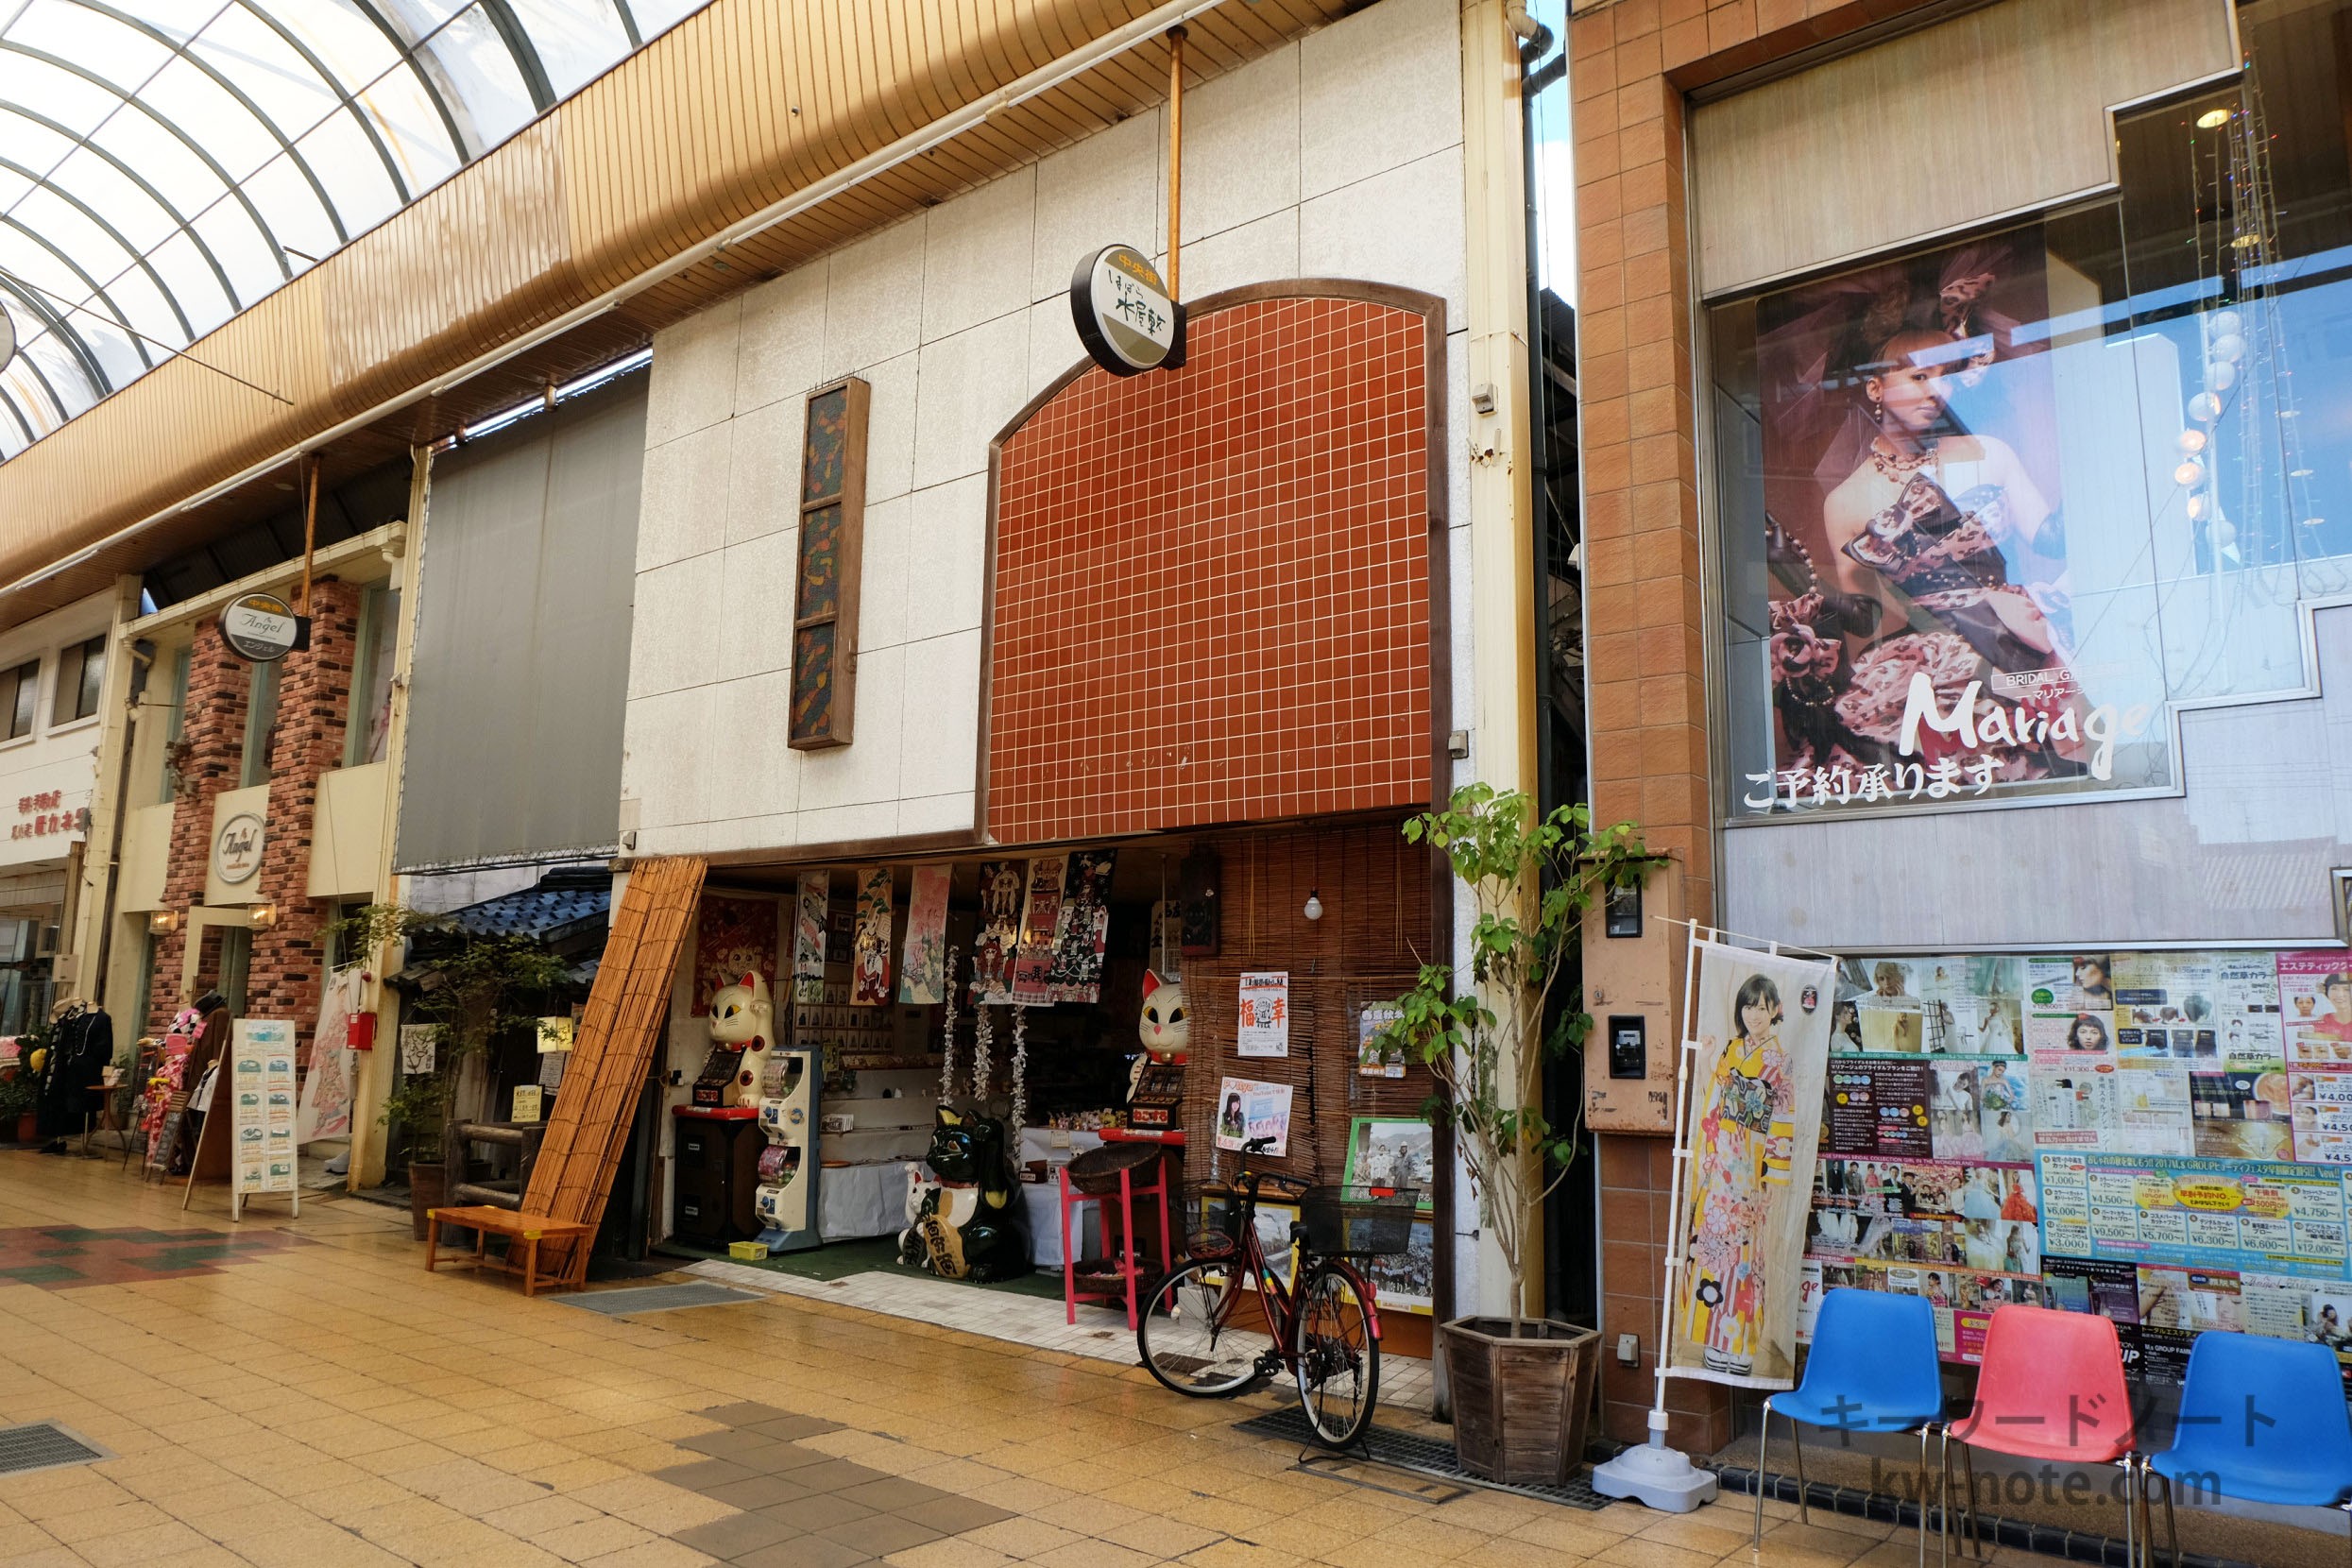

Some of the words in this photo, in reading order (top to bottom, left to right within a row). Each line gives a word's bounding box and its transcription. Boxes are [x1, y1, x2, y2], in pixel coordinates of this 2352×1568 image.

[1118, 254, 1158, 285] 中央街
[1116, 292, 1166, 336] 水屋敷
[240, 613, 285, 634] Angel
[2005, 673, 2054, 687] BRIDAL
[1897, 673, 2149, 780] Mariage
[1744, 754, 2004, 810] ご予約承ります
[222, 828, 258, 862] Angel
[1240, 998, 1255, 1028] 福
[1271, 997, 1286, 1029] 幸
